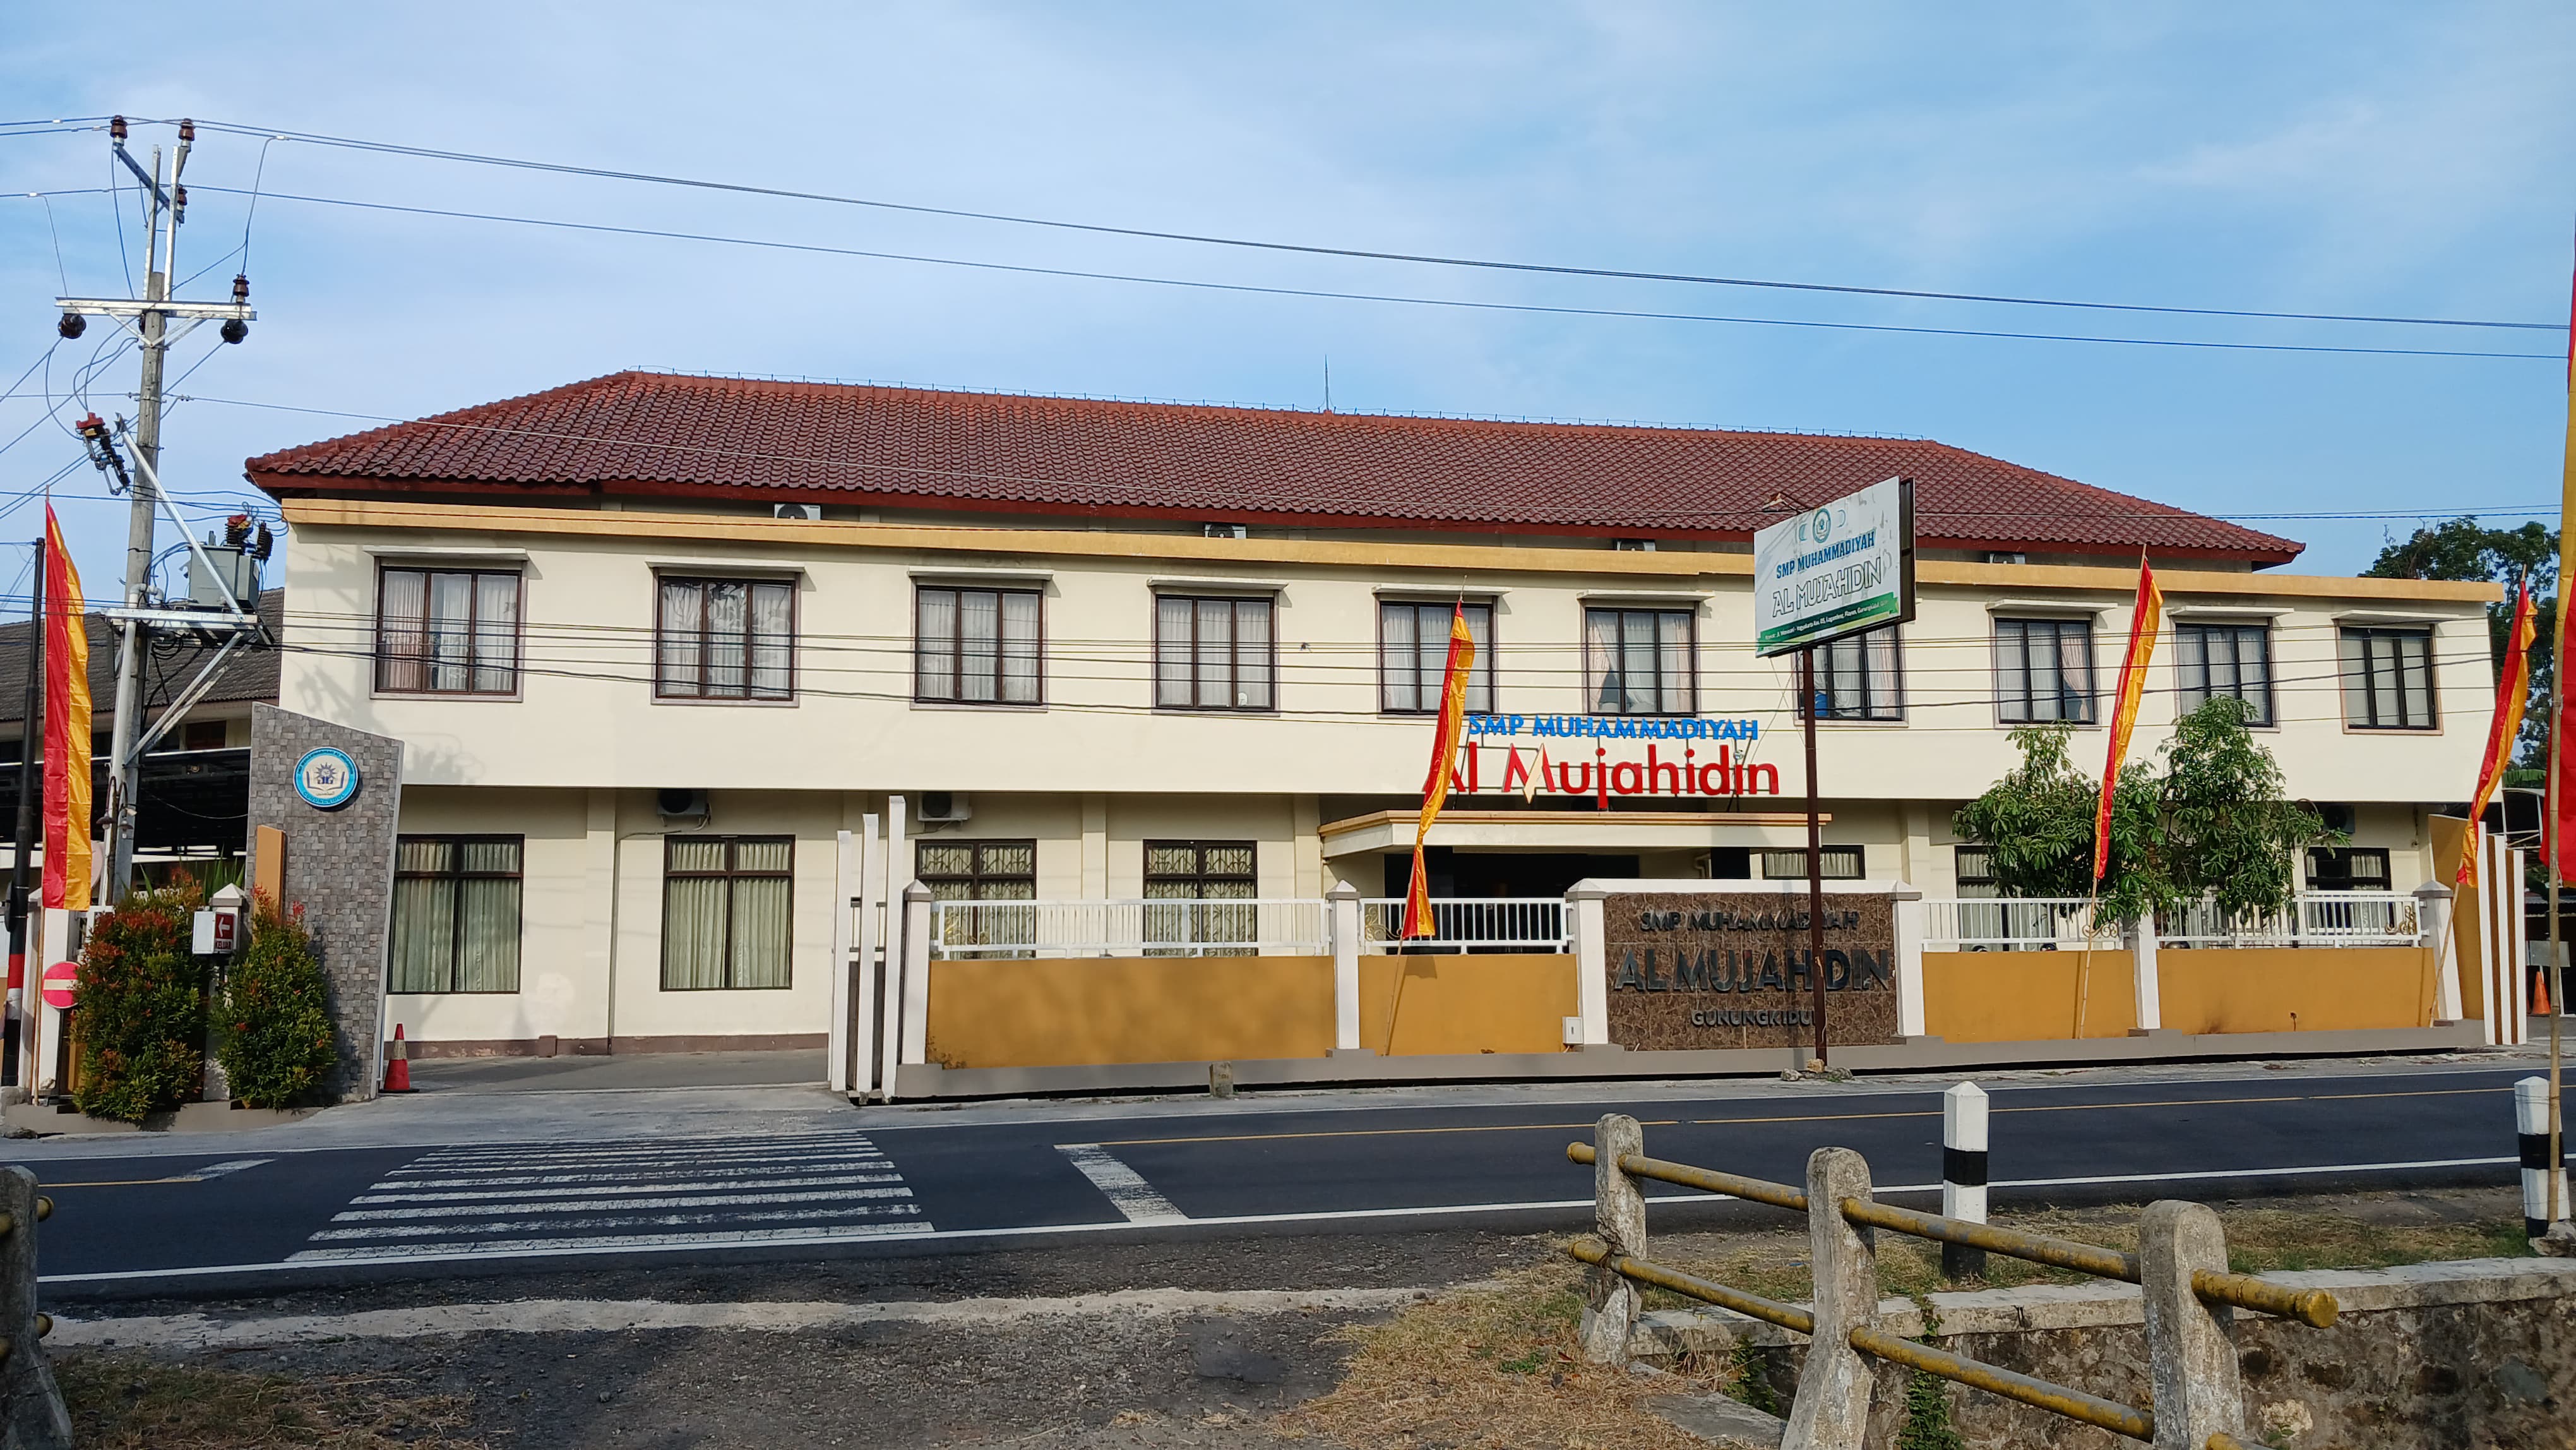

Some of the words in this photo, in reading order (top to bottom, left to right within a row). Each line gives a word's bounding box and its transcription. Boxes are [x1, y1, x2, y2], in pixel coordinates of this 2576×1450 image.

[1776, 560, 1795, 579] SMP
[1798, 531, 1875, 571] MUHAMMADIYAH
[1772, 588, 1794, 618] AL
[1796, 557, 1881, 610] MUJAHIDIN
[1469, 714, 1524, 735] SMP
[1532, 715, 1758, 740] MUHAMMADIYAH
[1502, 742, 1779, 809] Mujahidin
[1641, 911, 1681, 931] SMP
[1613, 949, 1667, 992] AL
[1673, 949, 1890, 993] MUJAHDIN
[1691, 1010, 1816, 1027] GUNUNGKIDU
